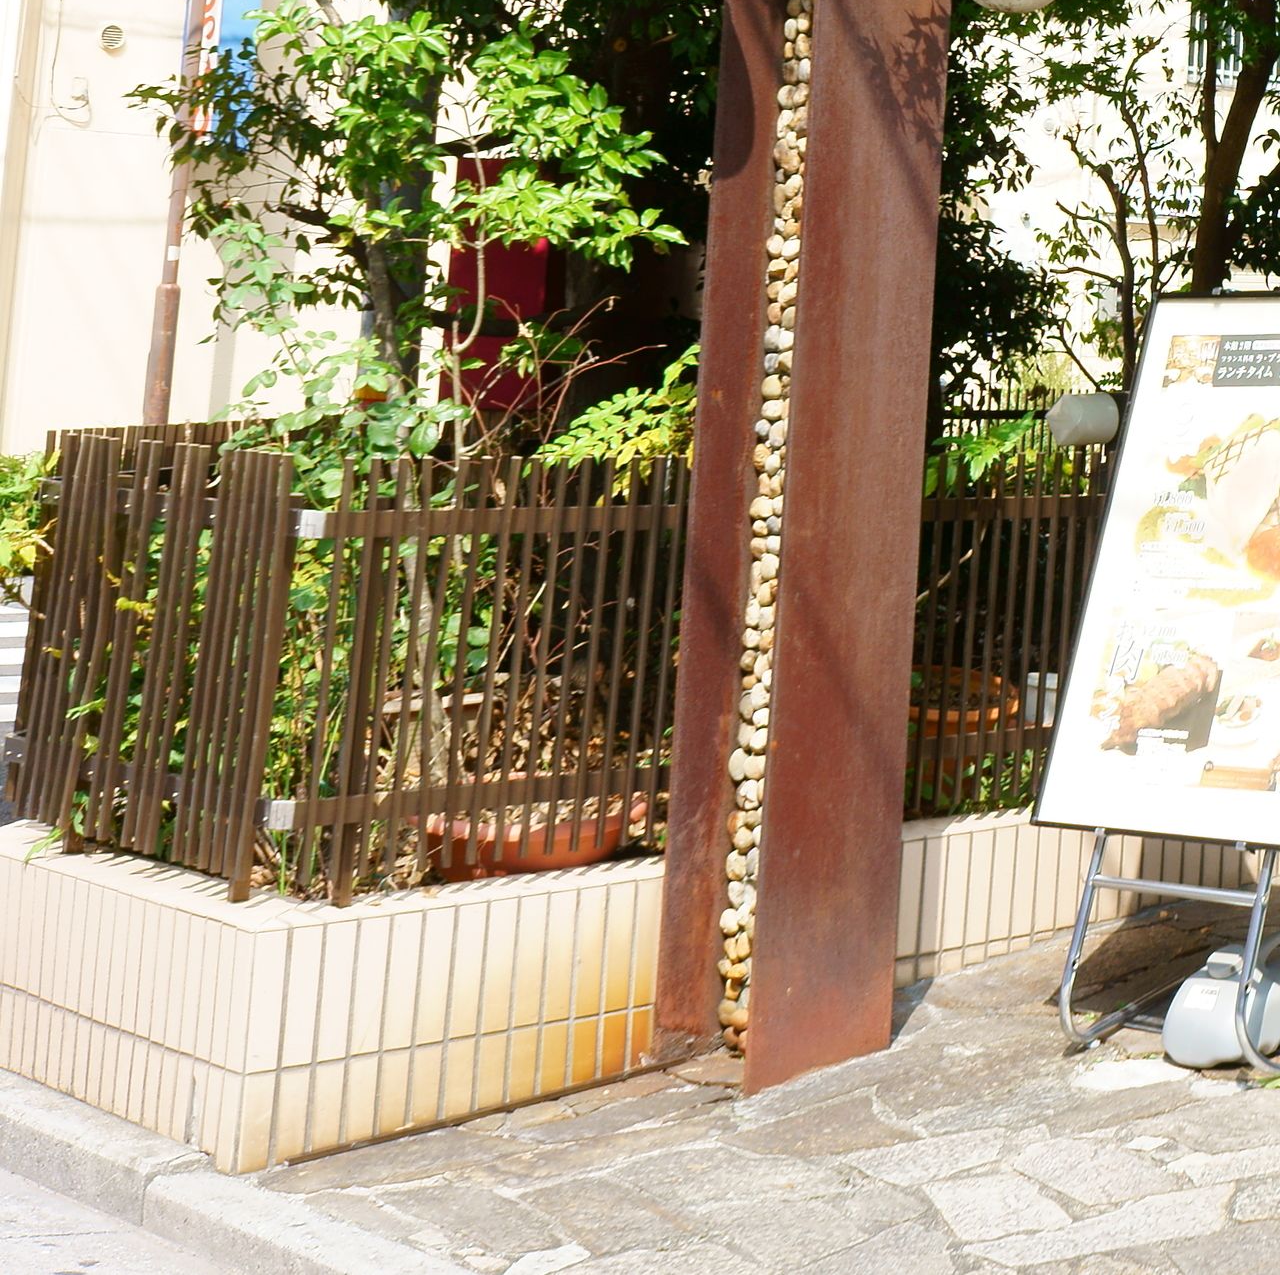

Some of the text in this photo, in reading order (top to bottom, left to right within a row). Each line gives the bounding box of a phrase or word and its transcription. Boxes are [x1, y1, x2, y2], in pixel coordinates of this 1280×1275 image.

[1218, 365, 1273, 380] ランチタイム
